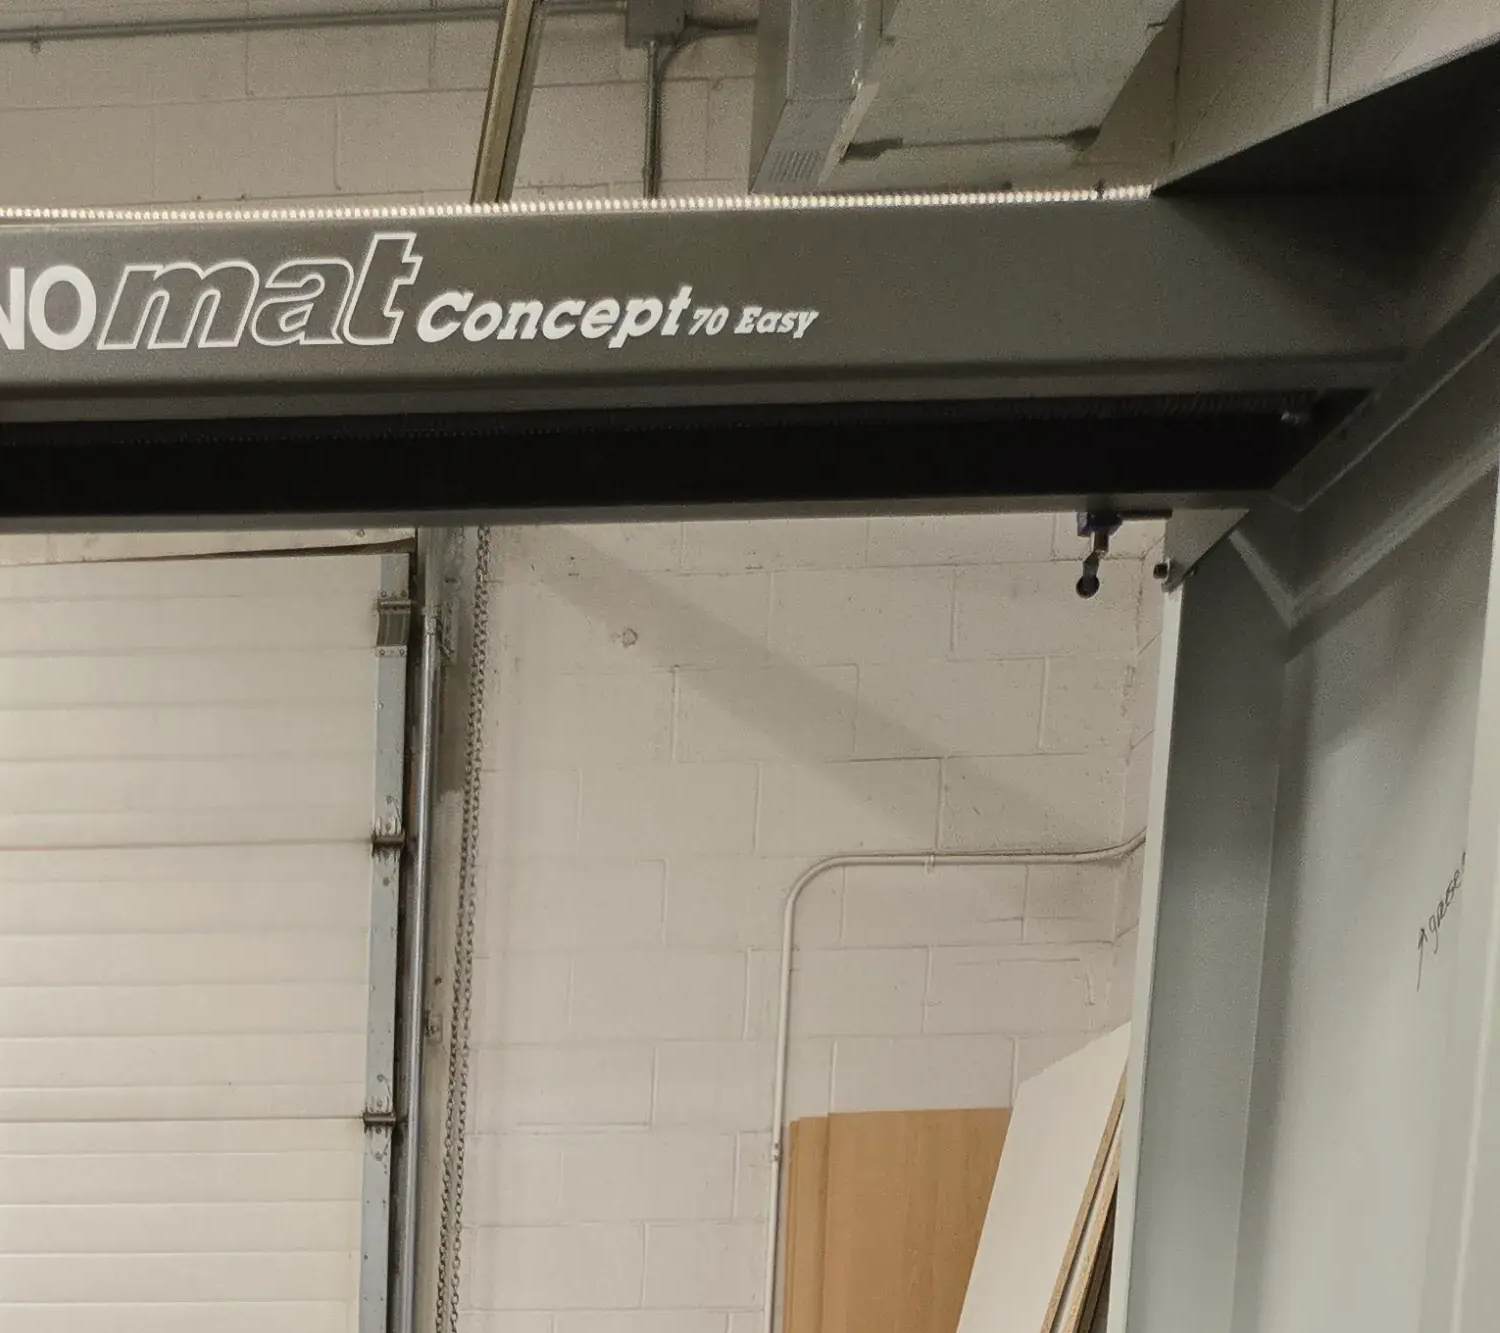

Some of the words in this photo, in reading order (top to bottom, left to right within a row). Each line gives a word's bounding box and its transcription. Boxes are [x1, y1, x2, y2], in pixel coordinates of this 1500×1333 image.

[416, 285, 693, 349] Concept
[688, 306, 730, 336] 70
[733, 305, 820, 340] Easy
